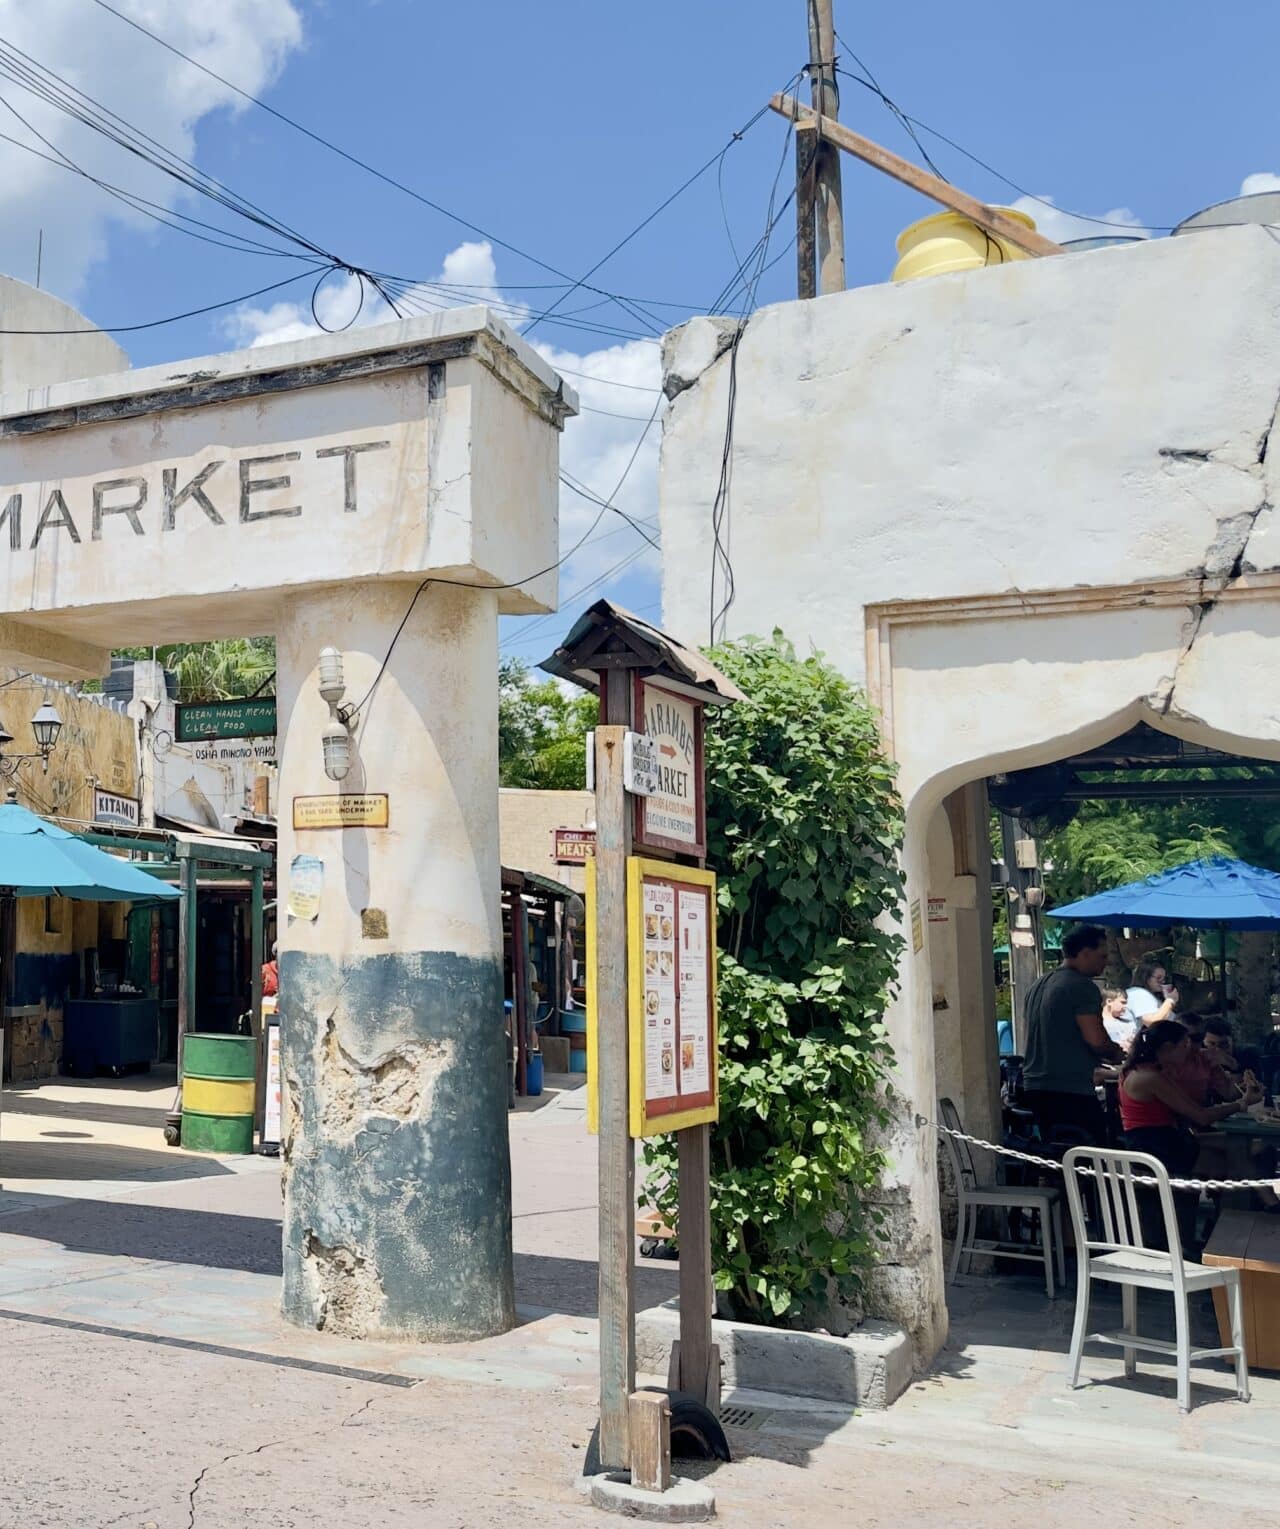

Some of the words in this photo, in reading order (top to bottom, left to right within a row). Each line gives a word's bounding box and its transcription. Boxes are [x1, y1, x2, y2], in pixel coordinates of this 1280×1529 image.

[184, 710, 212, 720] CLEAN
[216, 709, 242, 718] HANDS
[185, 722, 219, 733] CLEAN
[224, 721, 245, 730] FOOD
[195, 748, 218, 760] OSHA
[657, 764, 688, 799] ARKET
[99, 796, 135, 820] KITAMU
[557, 842, 593, 857] MEATS
